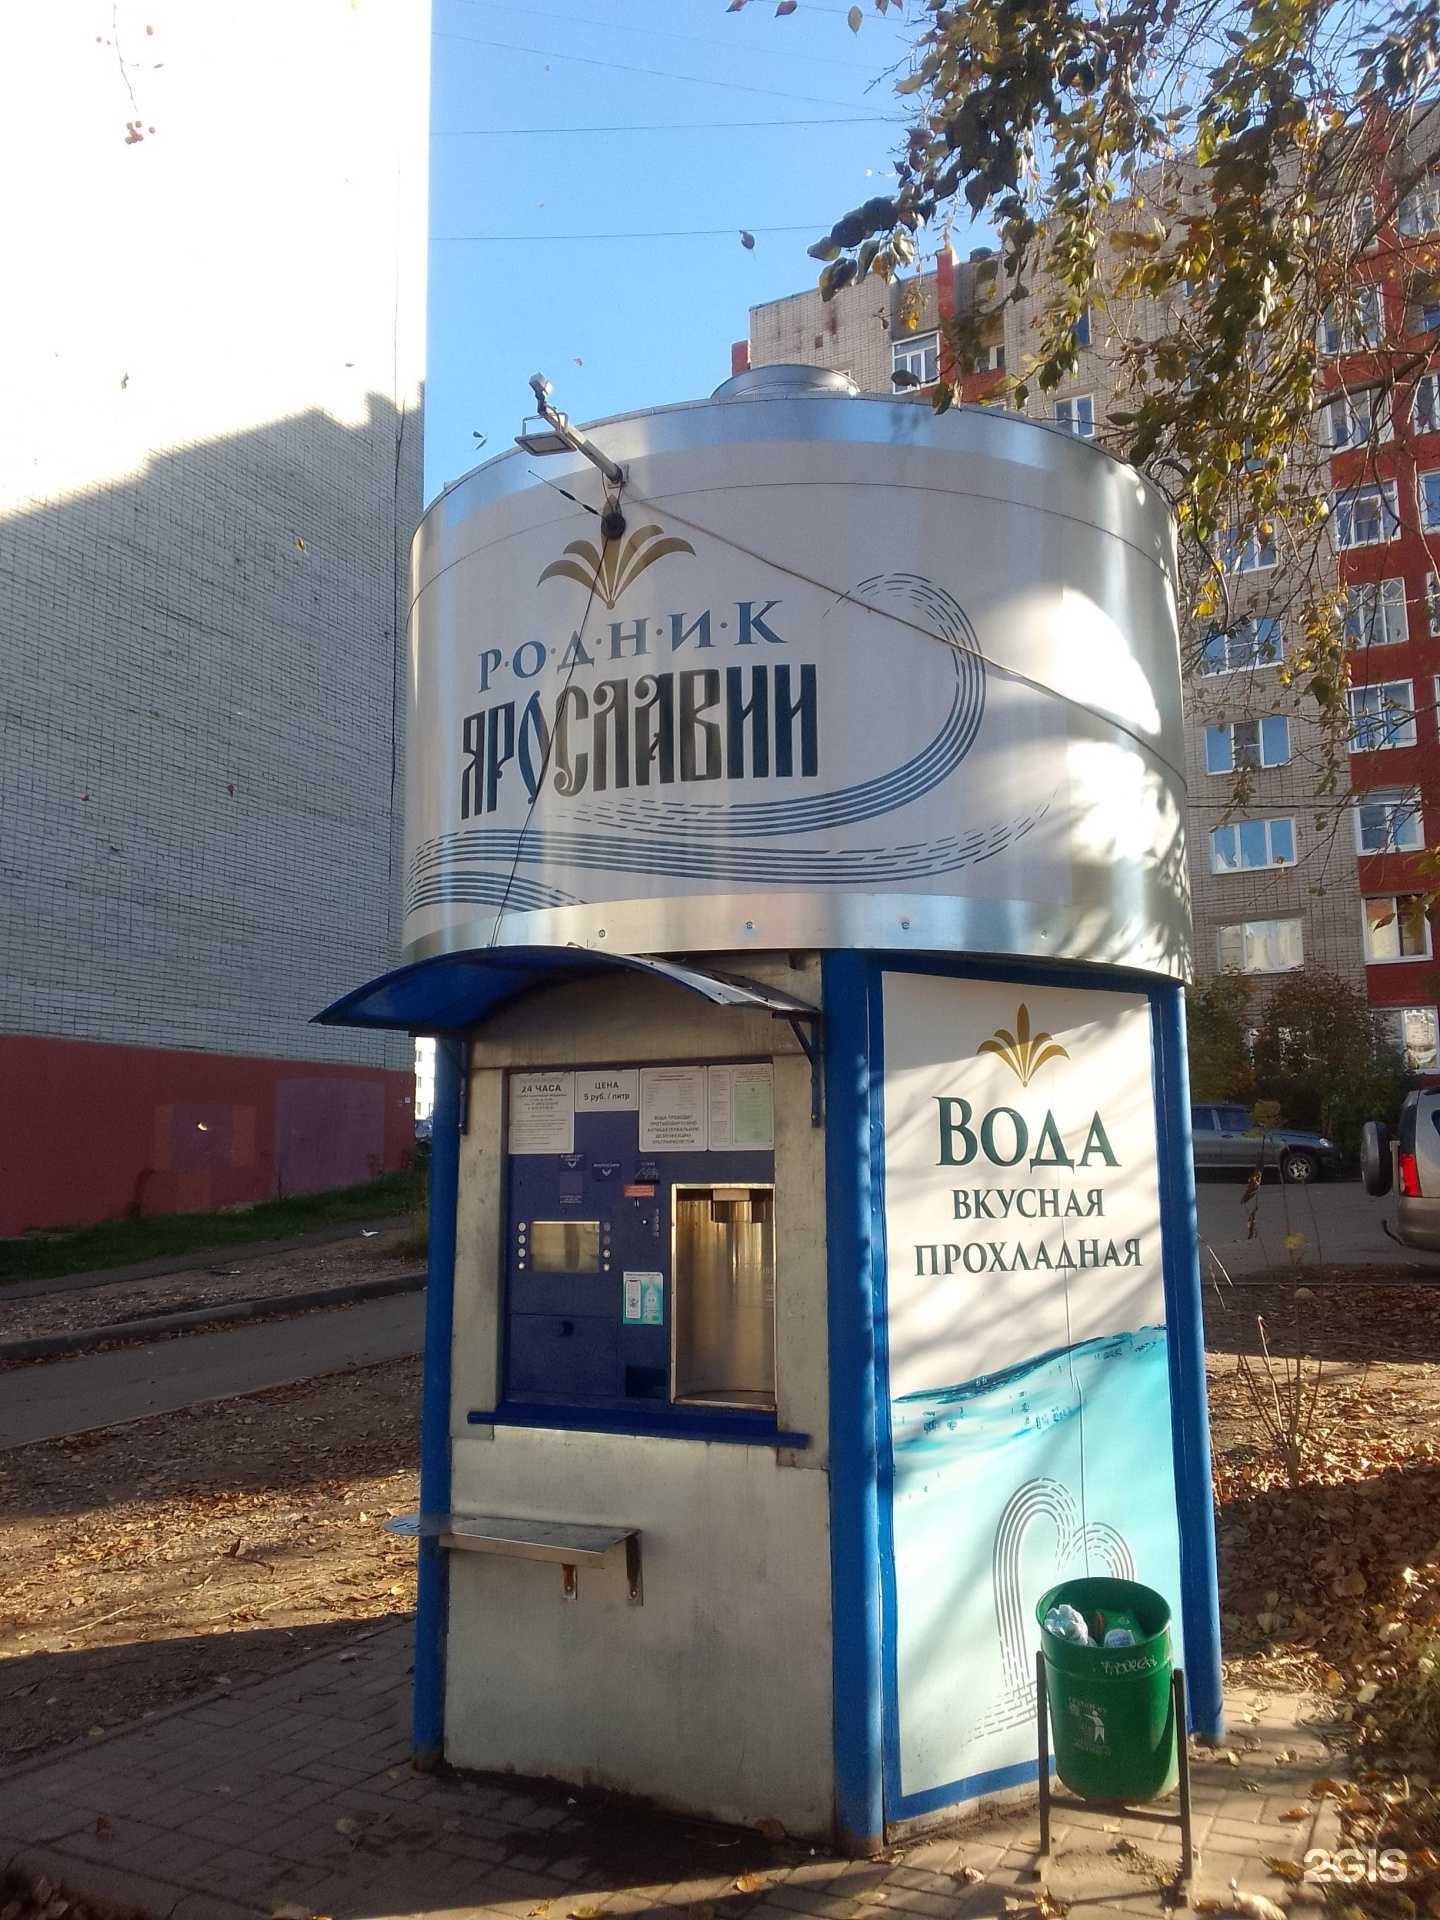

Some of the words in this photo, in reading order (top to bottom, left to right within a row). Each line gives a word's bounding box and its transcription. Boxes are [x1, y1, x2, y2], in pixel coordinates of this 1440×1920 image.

[461, 663, 819, 820] ЯРОСЛАВИИ
[521, 1085, 532, 1094] 24
[535, 1084, 562, 1092] ЧАСА
[583, 1093, 589, 1101] 5
[595, 1081, 619, 1090] ЦЕНА
[932, 1096, 1122, 1174] ВОДА
[951, 1188, 1105, 1220] ВКУСНАЯ
[914, 1238, 1144, 1276] ПРОХЛАДНАЯ
